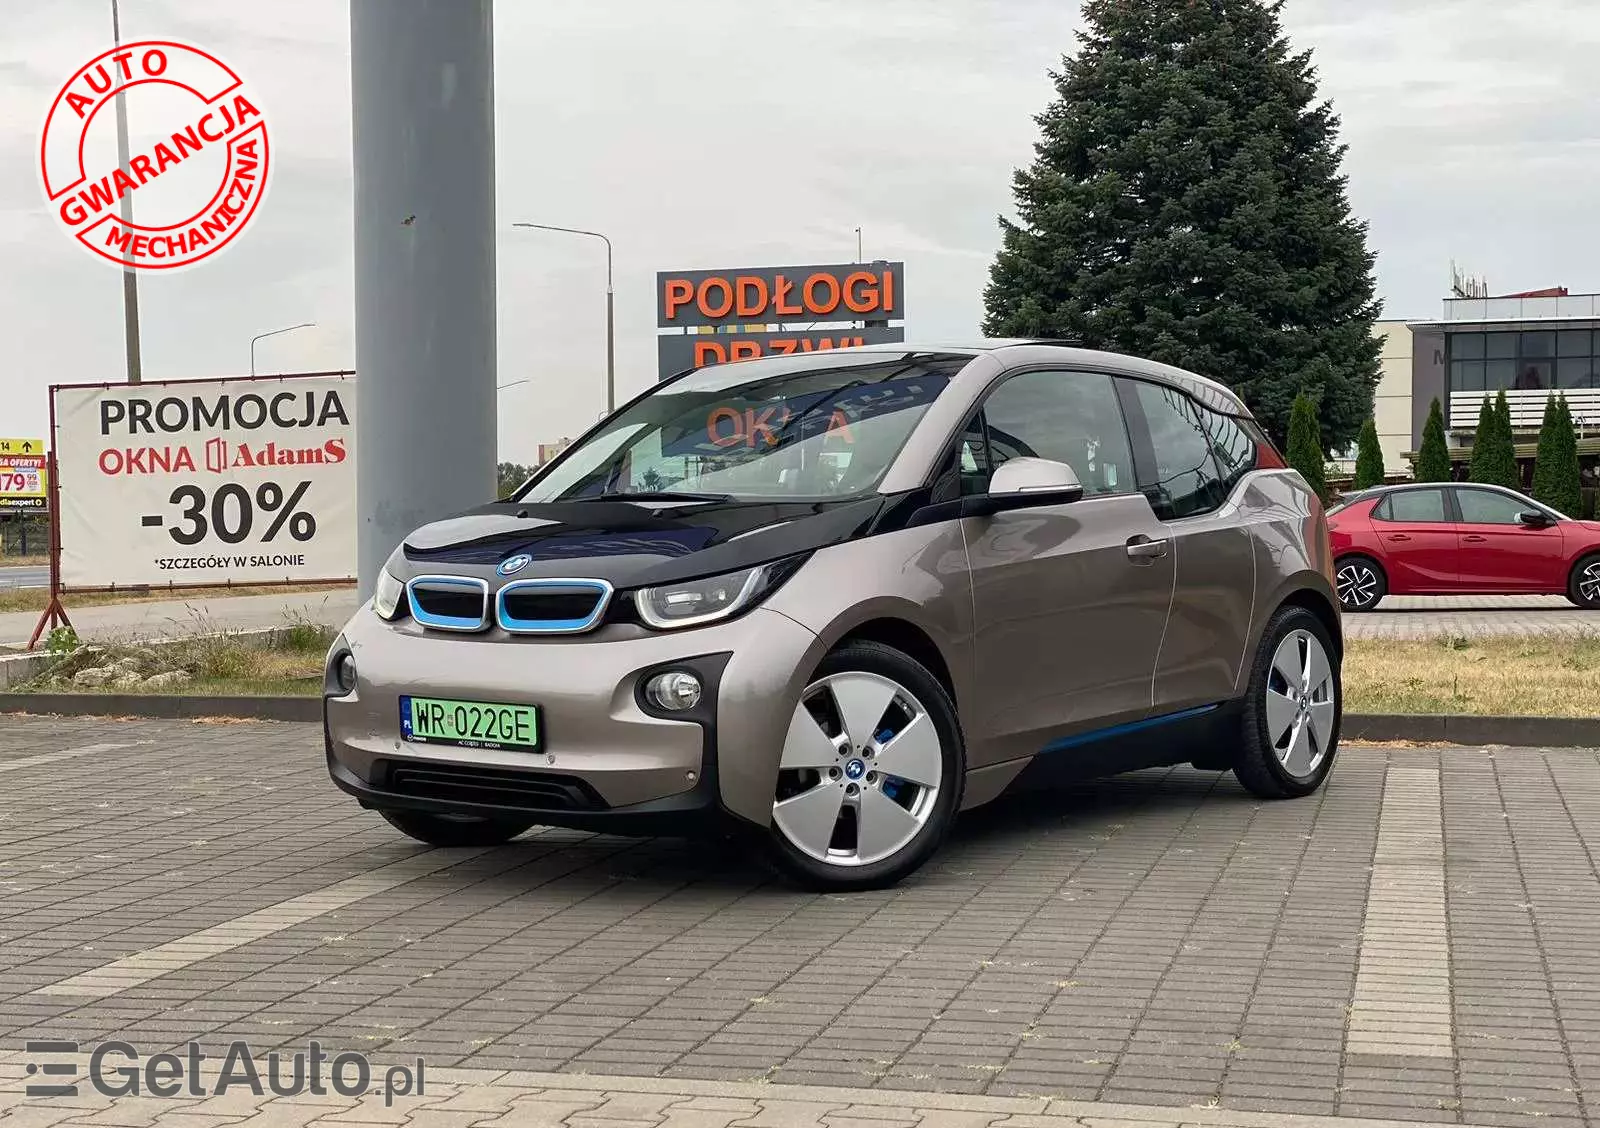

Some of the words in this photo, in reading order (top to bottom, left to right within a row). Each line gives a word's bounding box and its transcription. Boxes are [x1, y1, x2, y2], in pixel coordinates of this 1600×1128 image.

[665, 271, 893, 319] PODŁOGI
[100, 390, 350, 435] PROMOCJA
[706, 406, 855, 448] OKA
[98, 446, 197, 476] OKNA
[232, 438, 347, 469] AdamS
[141, 480, 316, 546] -30%
[234, 556, 247, 568] W
[250, 555, 305, 567] SALONIE
[403, 719, 412, 729] PL
[415, 702, 445, 735] WR
[454, 705, 530, 742] 022GE
